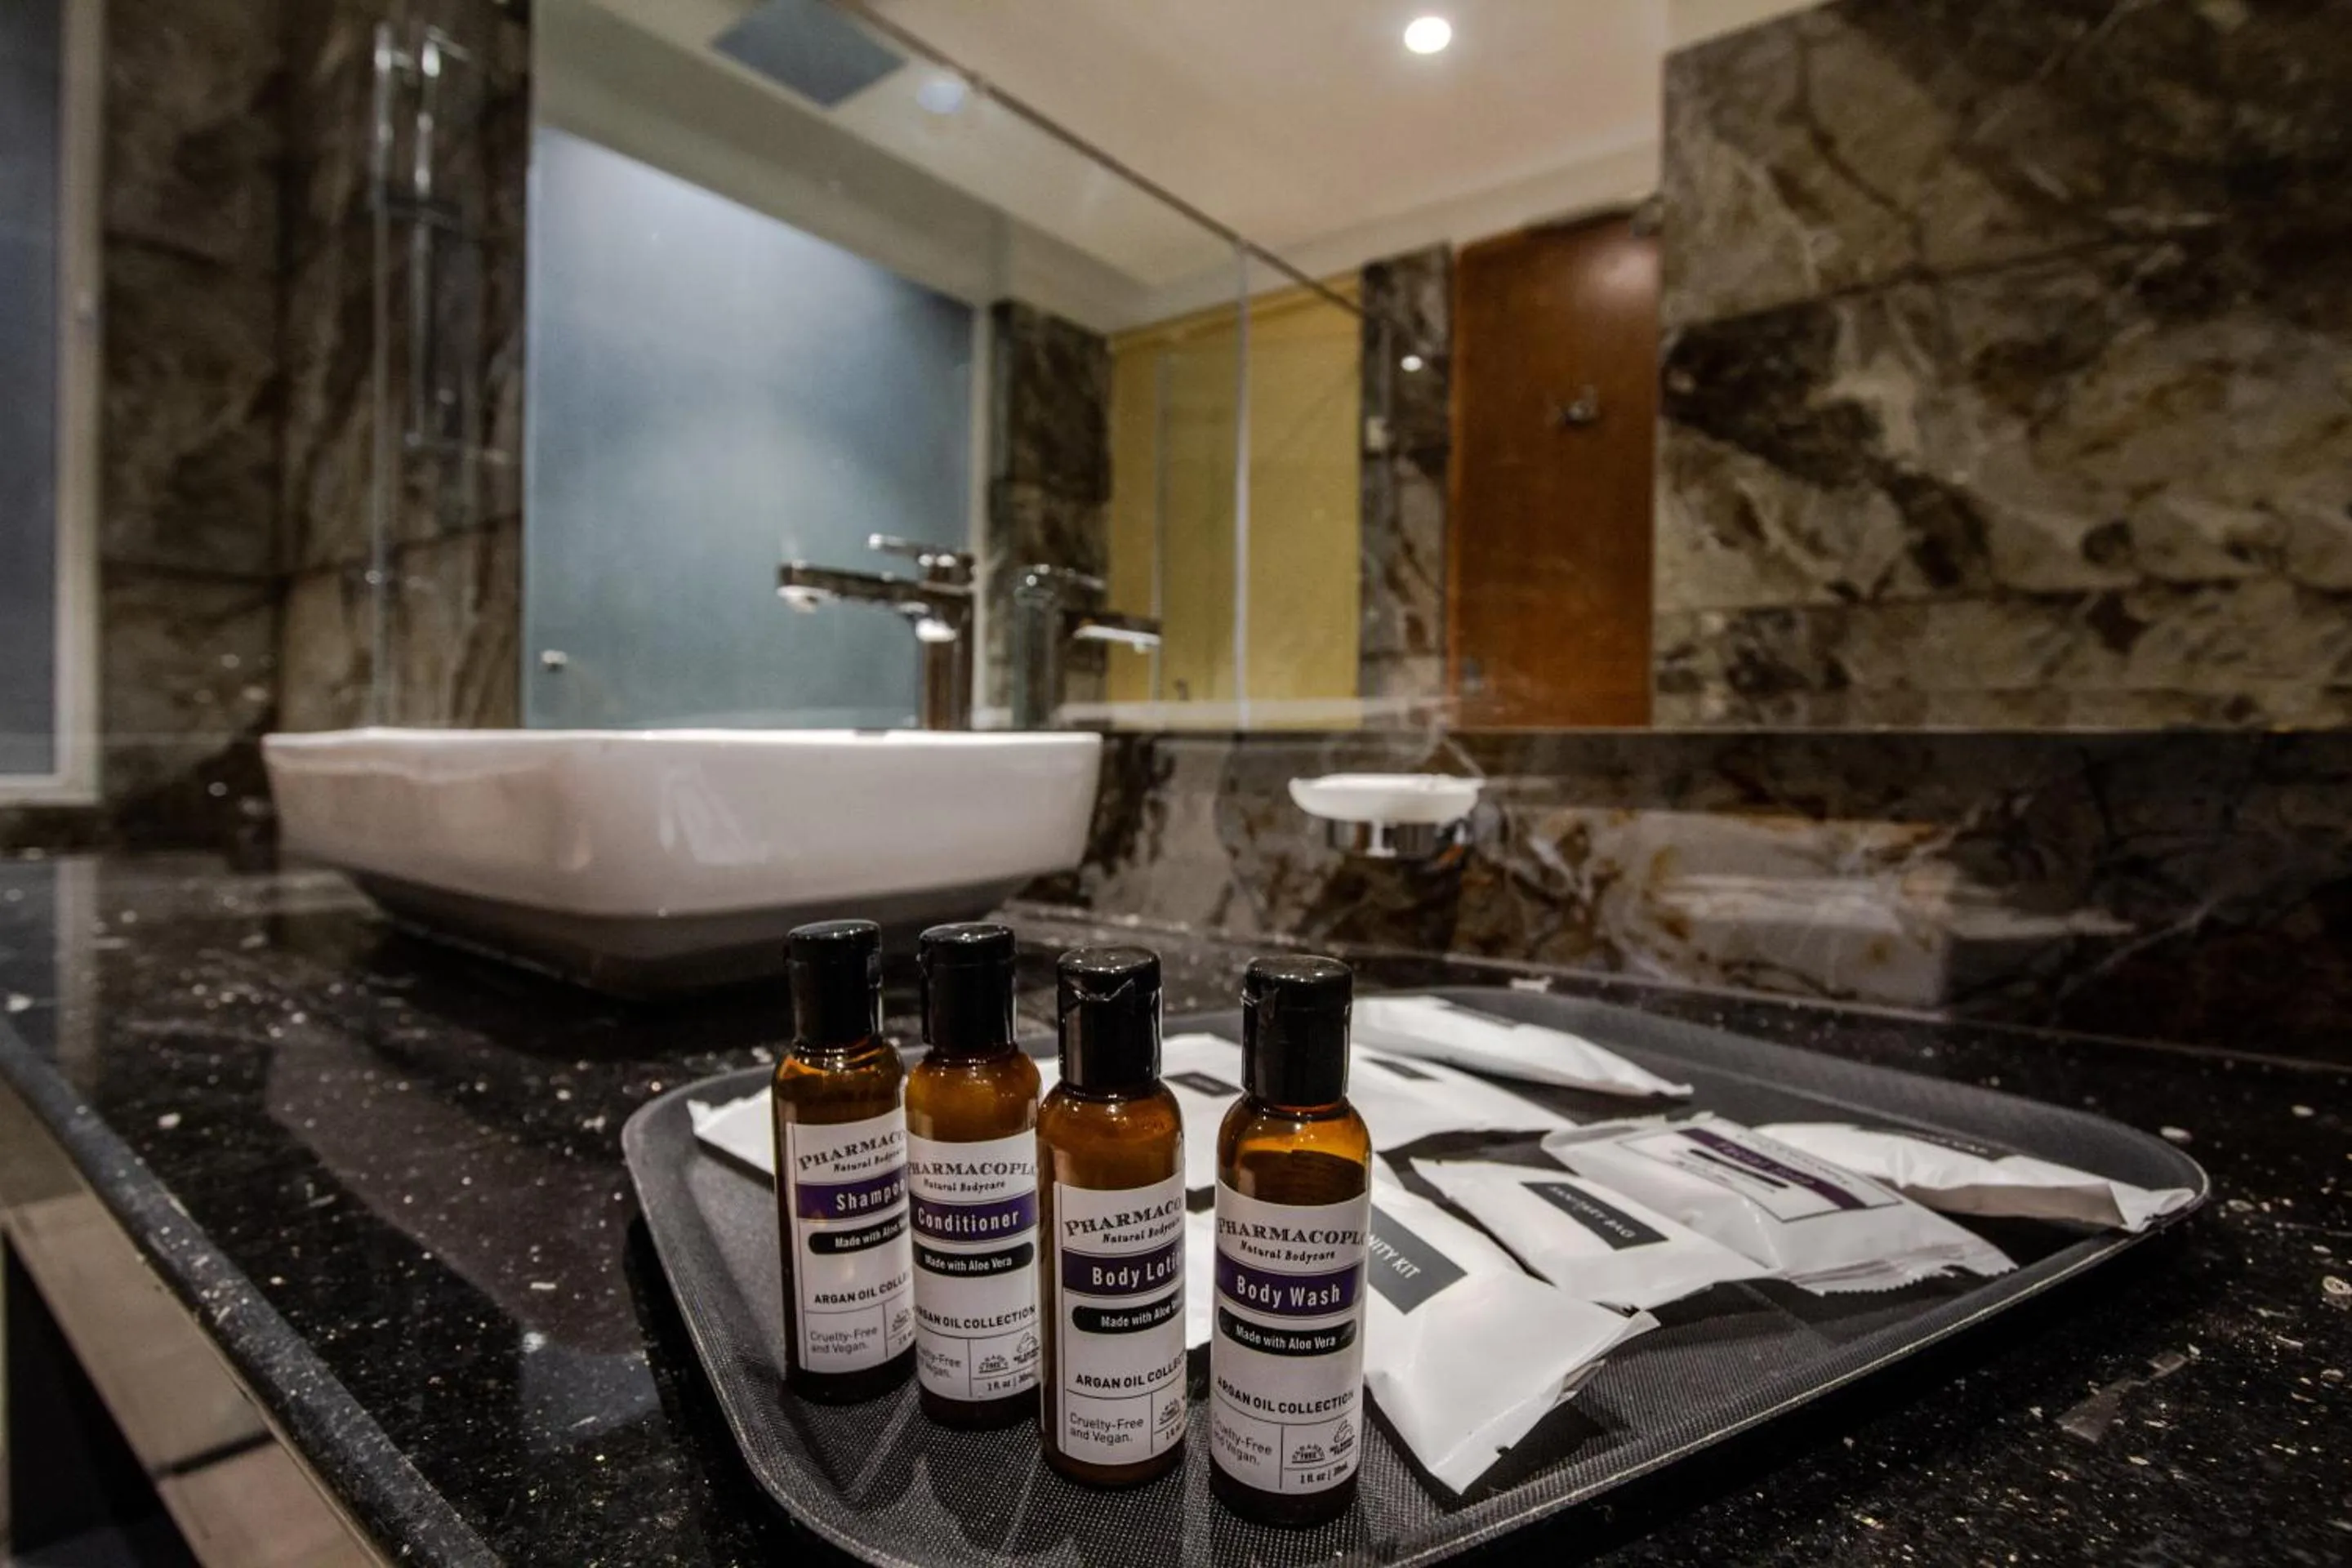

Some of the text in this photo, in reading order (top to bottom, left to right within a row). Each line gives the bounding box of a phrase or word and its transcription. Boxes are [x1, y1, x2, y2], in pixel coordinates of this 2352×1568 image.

[834, 1158, 871, 1172] Natural
[836, 1178, 906, 1210] Shampoo
[923, 1178, 1005, 1193] Natural Bodycare
[918, 1206, 1019, 1232] Conditioner
[835, 1236, 861, 1248] Made
[862, 1229, 882, 1243] with
[1102, 1231, 1145, 1243] Natural
[1240, 1240, 1335, 1265] Natural Bodycare
[924, 1254, 1013, 1271] Made with Aloe Vera
[1392, 1257, 1421, 1280] KIT
[1092, 1267, 1140, 1288] Body
[814, 1292, 856, 1303] ARGAN
[858, 1287, 877, 1300] OIL
[1236, 1275, 1340, 1308] Body Wash
[942, 1317, 961, 1329] OIL
[964, 1304, 1036, 1329] COLLECTION
[1101, 1316, 1129, 1327] Made
[1132, 1312, 1152, 1325] with
[810, 1327, 878, 1343] Cruelty-Free
[1236, 1324, 1337, 1350] Made with Aloe Vera
[812, 1343, 830, 1353] and
[1075, 1373, 1120, 1388] ARGAN
[1123, 1376, 1145, 1388] OIL
[1253, 1396, 1275, 1412] OIL
[1070, 1412, 1144, 1432] Cruelty-Free
[1070, 1428, 1133, 1446] and Vegan.
